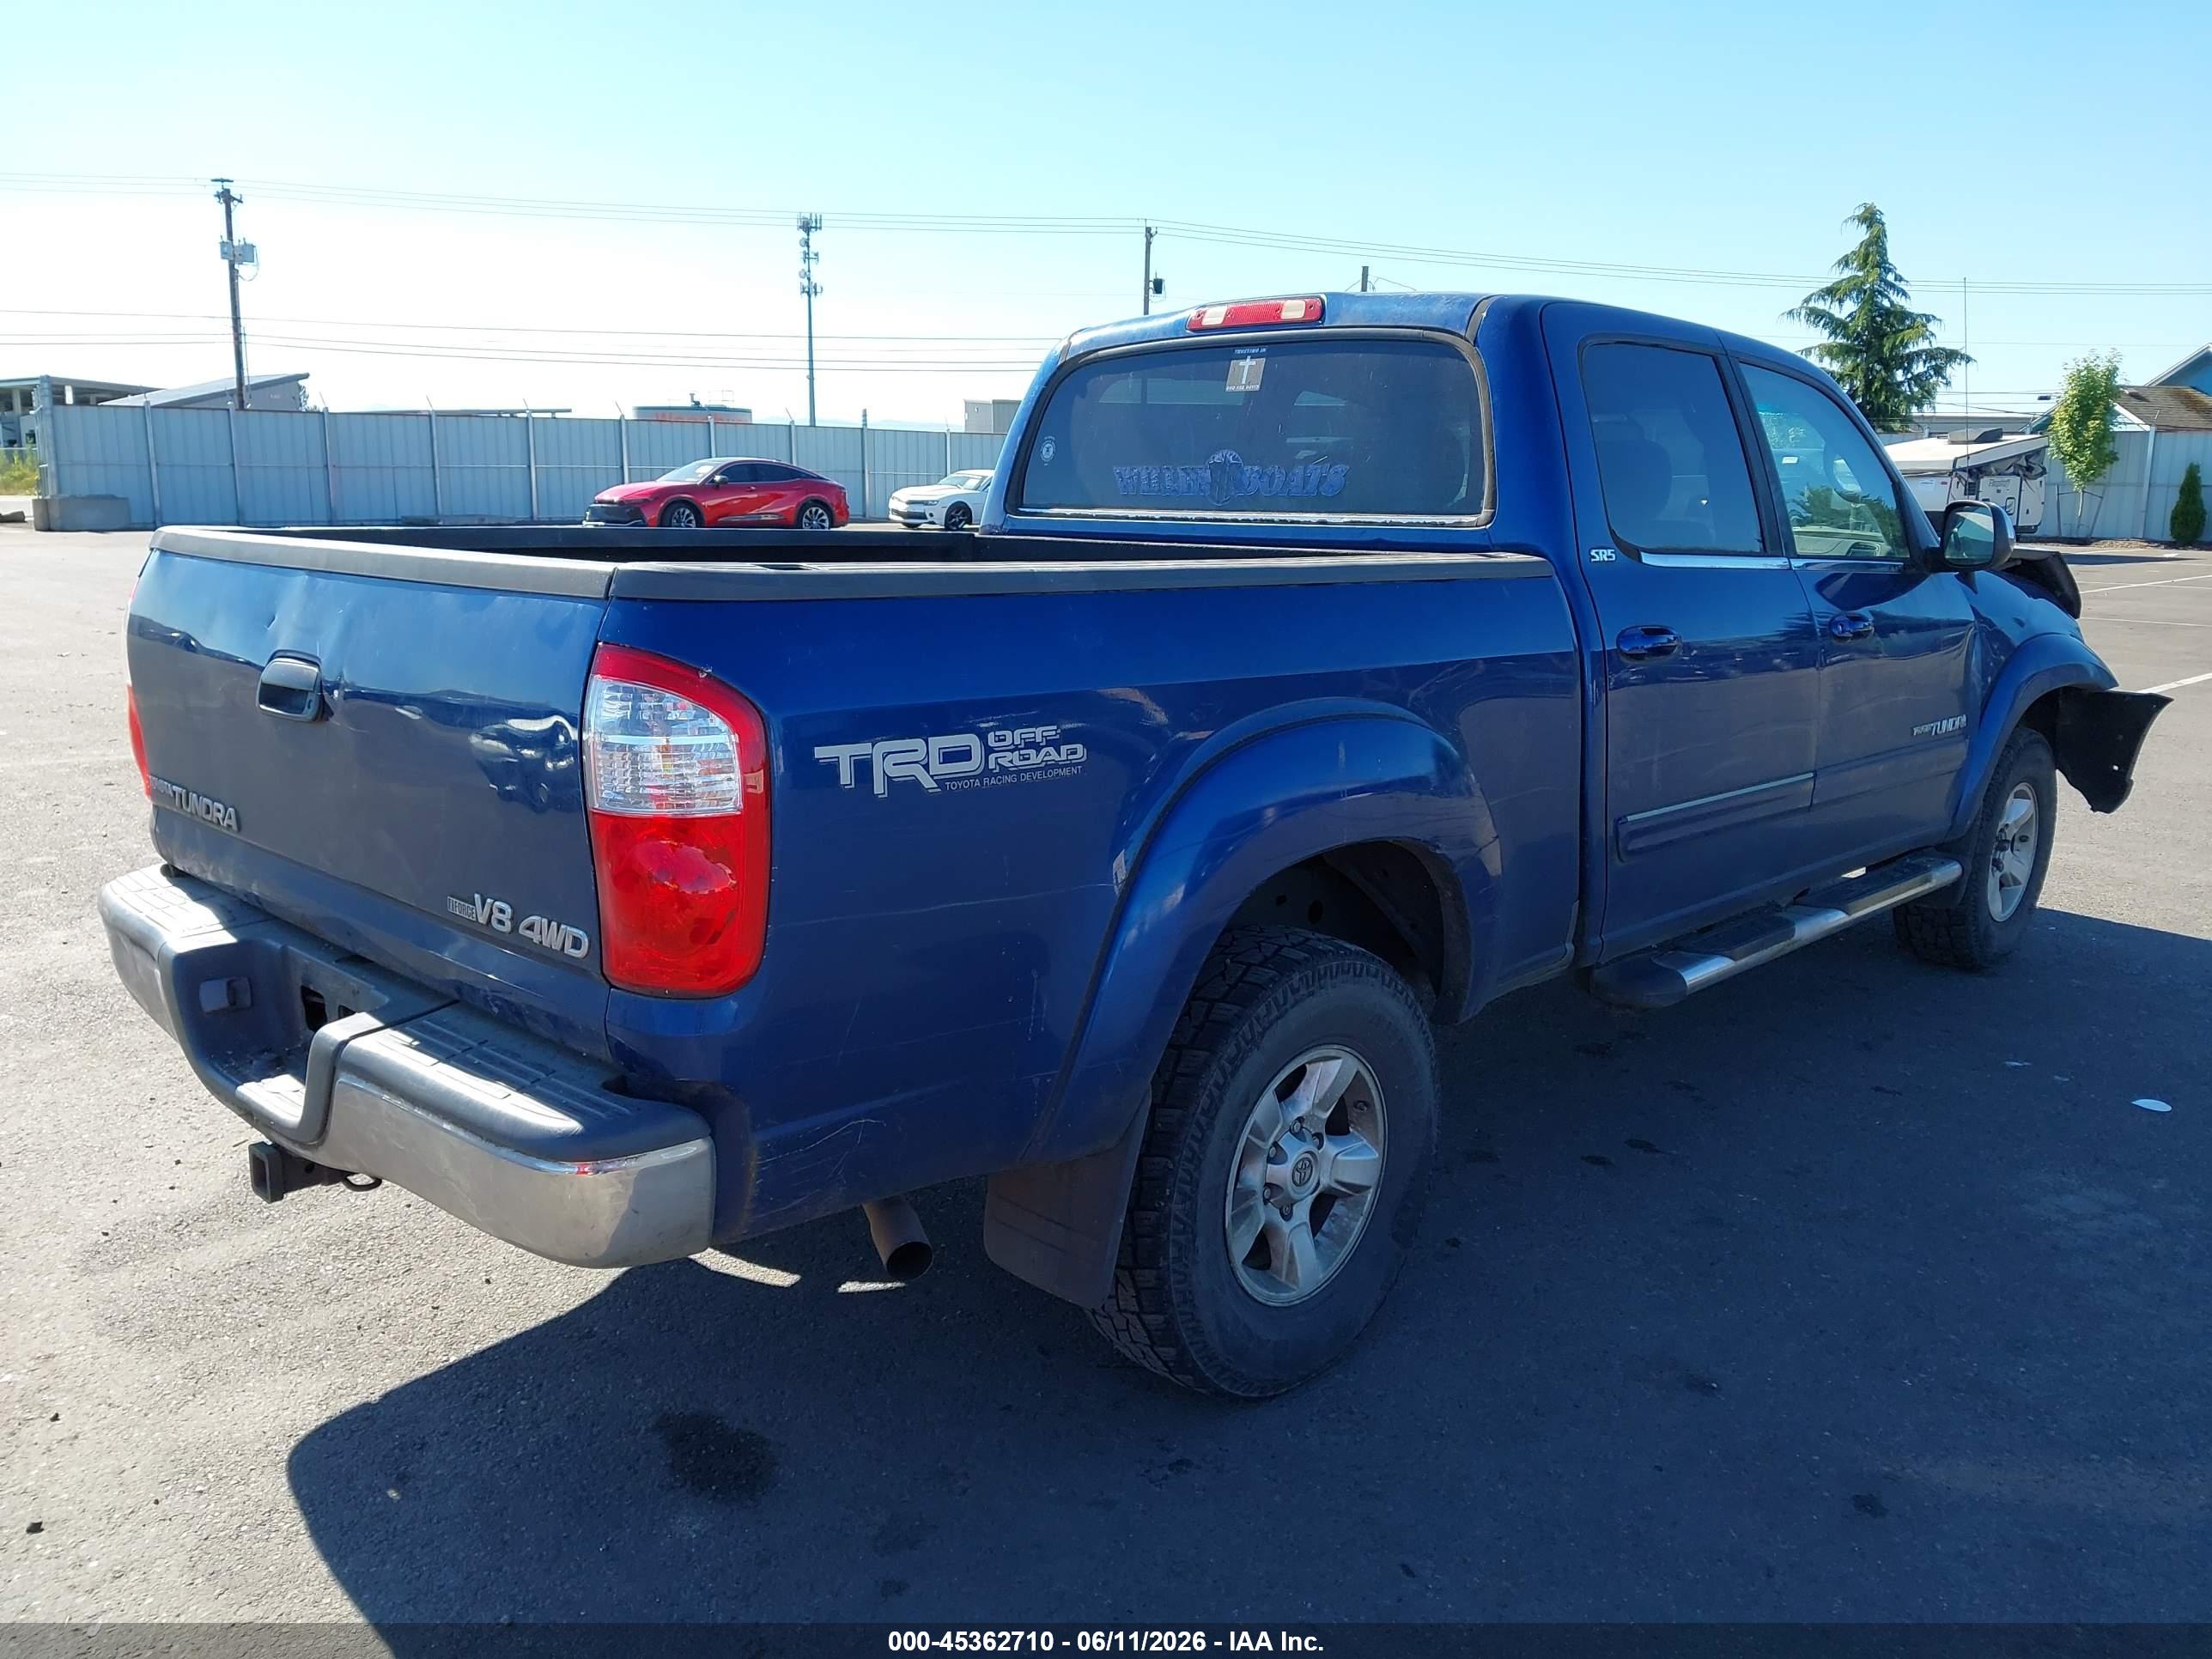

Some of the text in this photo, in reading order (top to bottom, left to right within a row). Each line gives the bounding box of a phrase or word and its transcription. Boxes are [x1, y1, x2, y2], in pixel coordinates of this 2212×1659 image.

[1237, 465, 1349, 496] BOATS
[1590, 549, 1616, 562] SR5
[988, 725, 1061, 750] OFF
[1929, 714, 1966, 736] TUNDRA
[814, 733, 985, 798] TRD
[988, 743, 1087, 772] ROAD
[945, 765, 1083, 791] TOYOTA RACING DEVELOPMENT
[173, 785, 238, 832] TUNDRA
[474, 892, 513, 934] V8
[519, 915, 590, 960] 4WD
